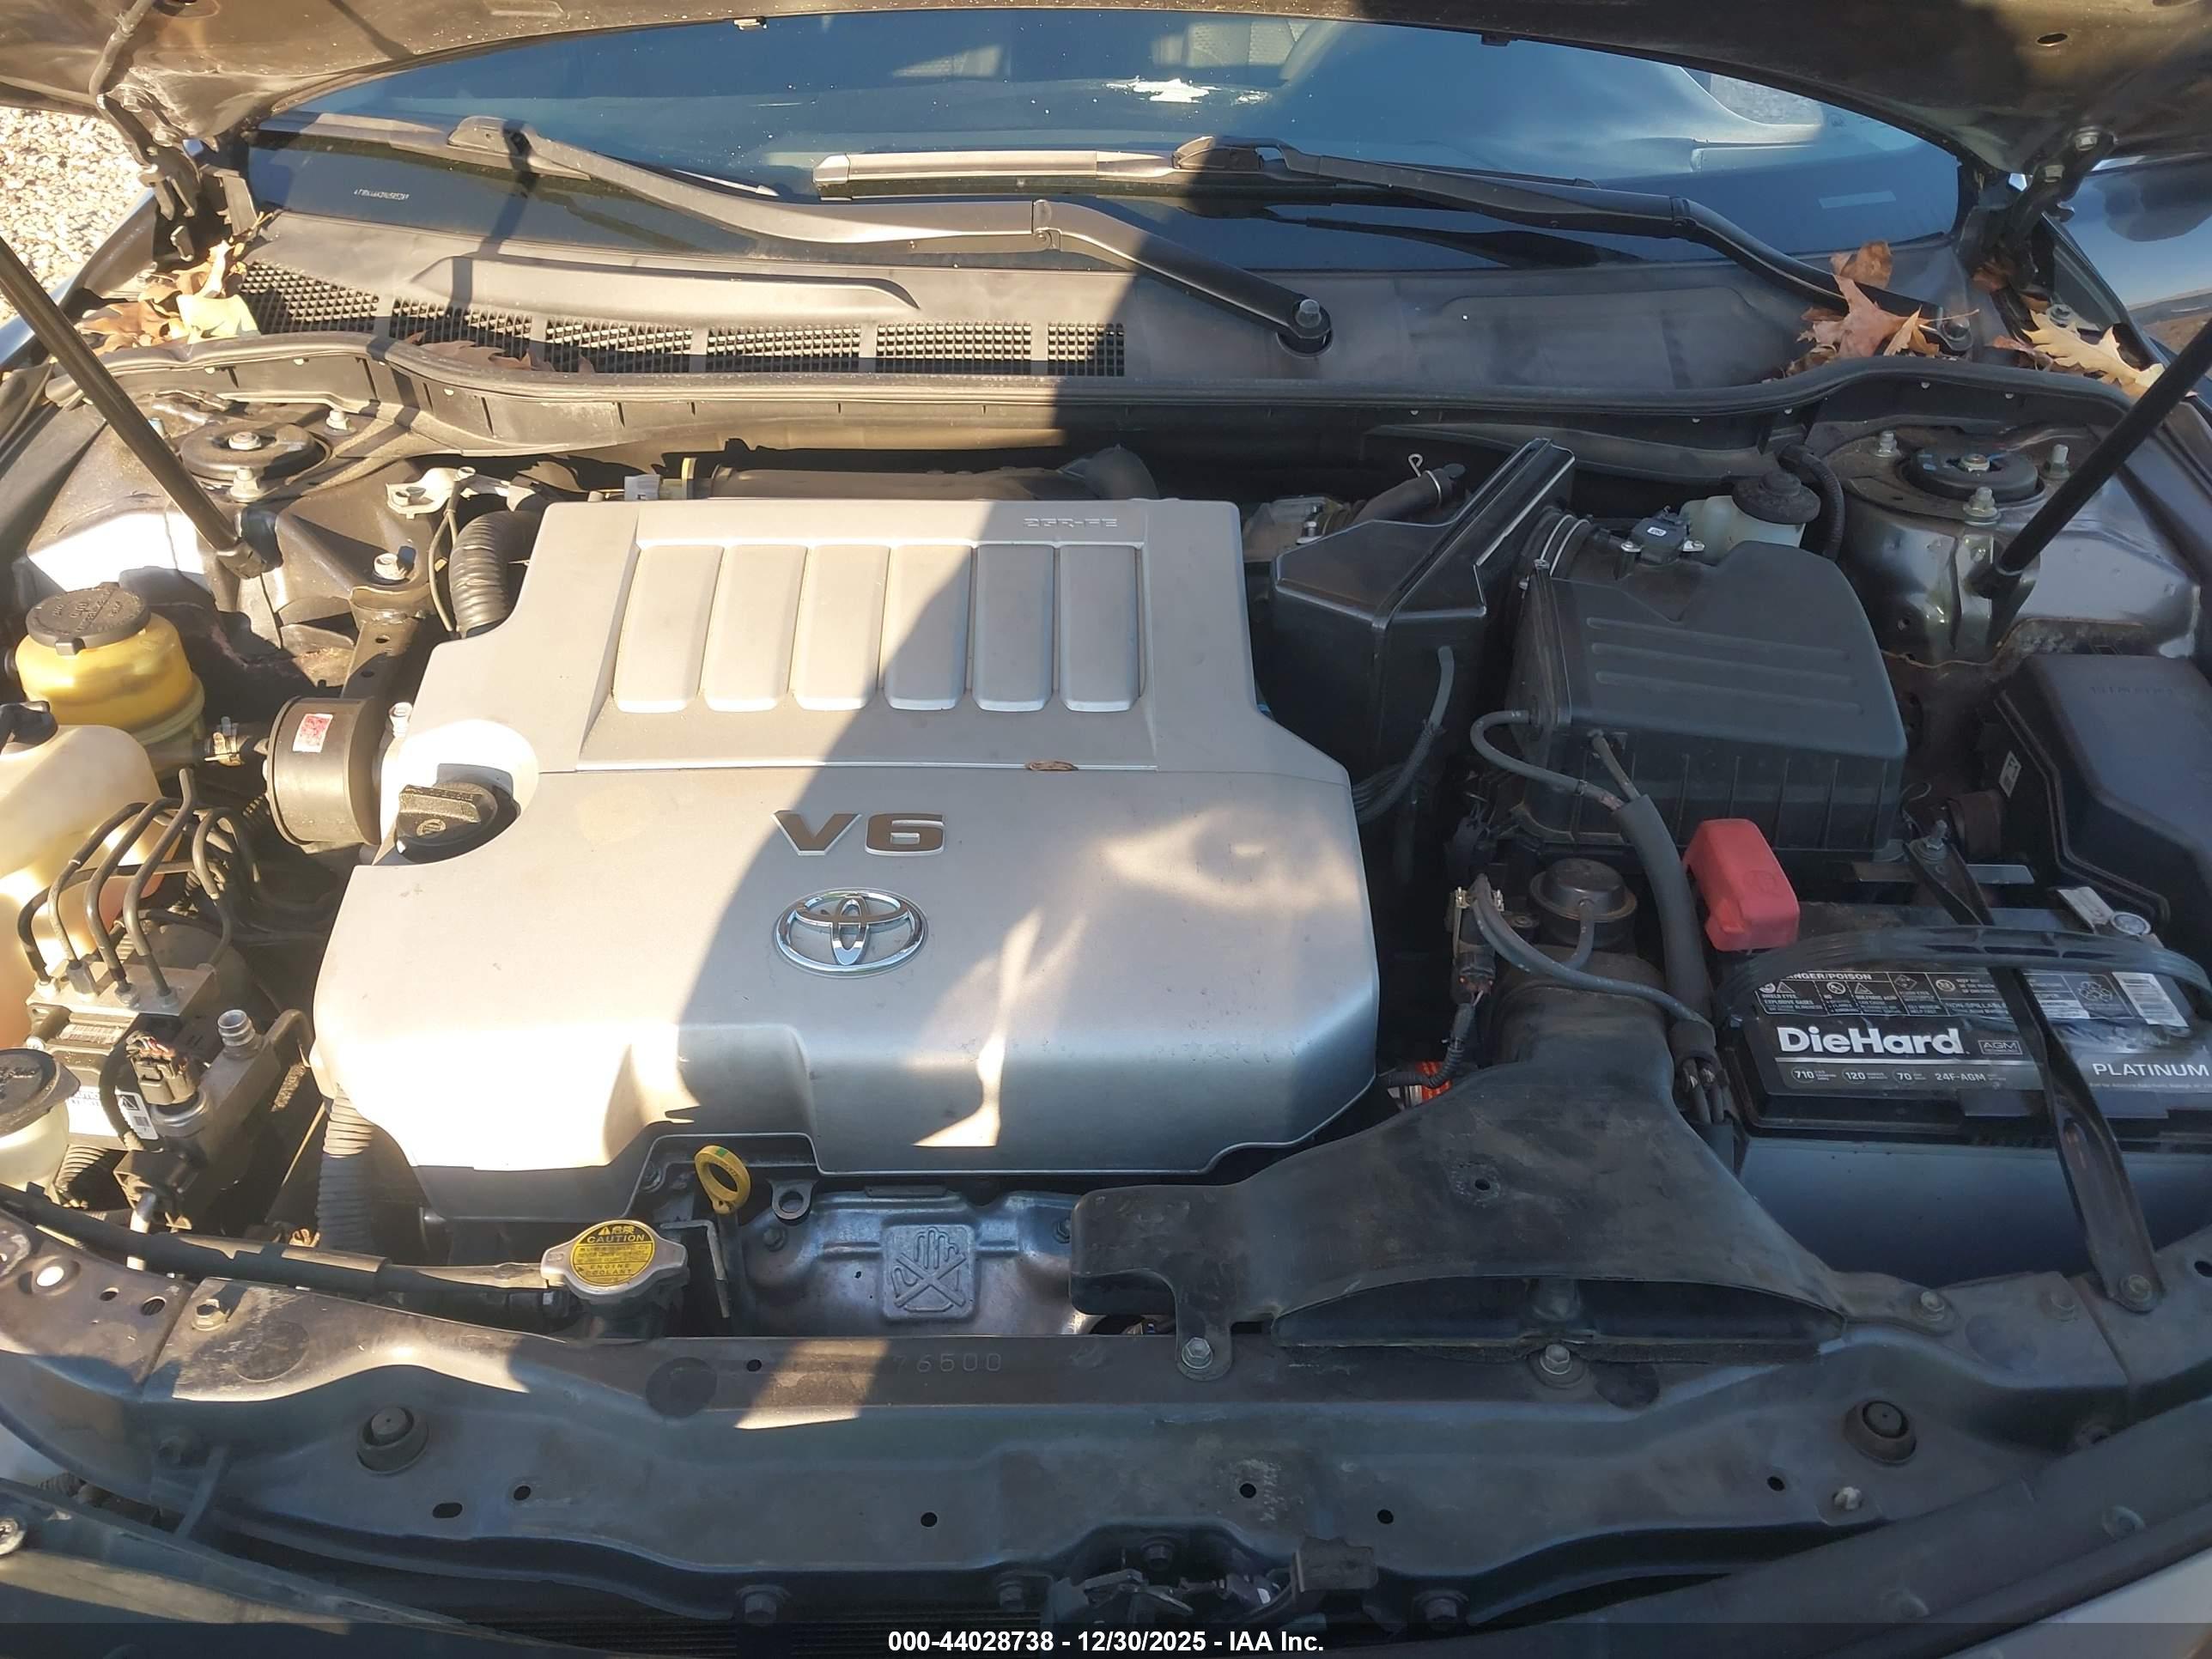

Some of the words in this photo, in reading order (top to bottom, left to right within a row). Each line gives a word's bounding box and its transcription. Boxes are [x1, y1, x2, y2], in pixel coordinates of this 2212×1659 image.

[1023, 517, 1118, 528] 2GR-FE
[771, 810, 945, 857] V6
[1786, 971, 1873, 981] NGER/POISON
[1777, 1026, 1965, 1054] DieHard
[1983, 1042, 2018, 1050] AGM
[1794, 1070, 1814, 1079] 710
[2092, 1063, 2210, 1077] PLATINUM
[1844, 1072, 1866, 1080] 120
[1896, 1072, 1913, 1081] 70
[1935, 1073, 1986, 1083] 24F-AGM
[586, 1234, 645, 1243] CAUTION
